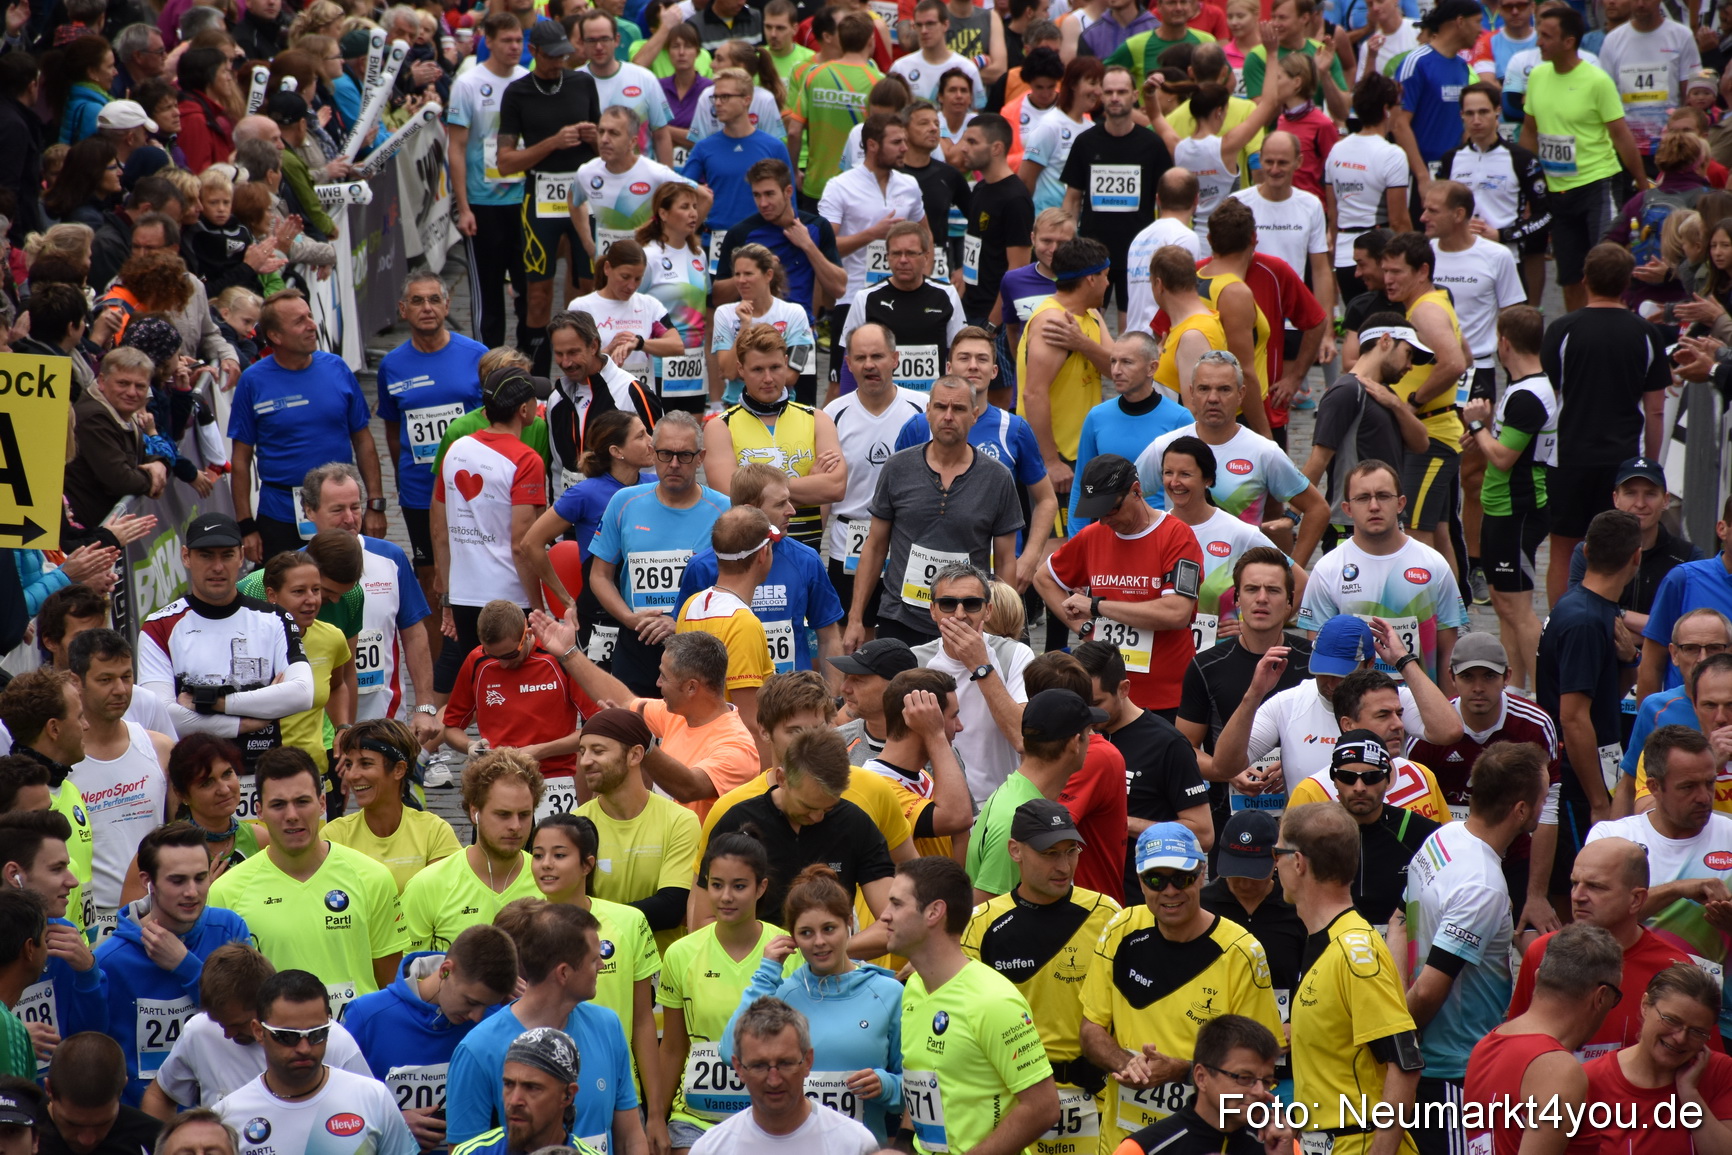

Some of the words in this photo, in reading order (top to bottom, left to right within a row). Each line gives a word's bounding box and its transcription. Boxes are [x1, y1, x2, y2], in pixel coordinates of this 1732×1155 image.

[1634, 74, 1654, 89] 44
[813, 88, 866, 106] BOCK
[1541, 143, 1572, 161] 2780
[1096, 177, 1136, 194] 2236
[1101, 197, 1128, 206] Andreas
[668, 360, 702, 378] 3080
[425, 411, 454, 420] Neumarkt
[414, 418, 457, 443] 310
[1229, 463, 1251, 472] Hervis
[852, 533, 869, 554] 2
[1210, 545, 1231, 554] Hervis
[650, 557, 681, 565] Neumarkt
[911, 550, 929, 561] PARTL
[635, 566, 687, 590] 2697
[1090, 574, 1149, 588] NEUMARKT
[1408, 571, 1428, 581] Hervis
[645, 595, 676, 605] Markus
[1102, 623, 1140, 647] 335
[356, 644, 380, 670] 50
[519, 681, 557, 694] Marcel
[86, 803, 102, 813] Pure
[103, 792, 146, 809] Performance
[548, 793, 577, 816] 32
[1229, 843, 1261, 852] ORACLE
[97, 915, 118, 923] PART
[325, 914, 351, 925] Partl
[992, 915, 1014, 933] STANNO
[1445, 923, 1482, 945] BOCK
[1063, 946, 1078, 954] TSV
[994, 957, 1035, 971] Steffen
[1128, 968, 1154, 988] Peter
[1202, 987, 1219, 996] TSV
[139, 1006, 166, 1016] PARTL
[1001, 1021, 1026, 1040] zerbock
[926, 1036, 945, 1051] Partl
[692, 1049, 716, 1058] PARTL
[1016, 1060, 1031, 1072] BMW
[388, 1073, 419, 1082] PARTL
[704, 1097, 751, 1111] Vanessa
[331, 1119, 361, 1131] Hervis
[1037, 1142, 1076, 1155] Steffen
